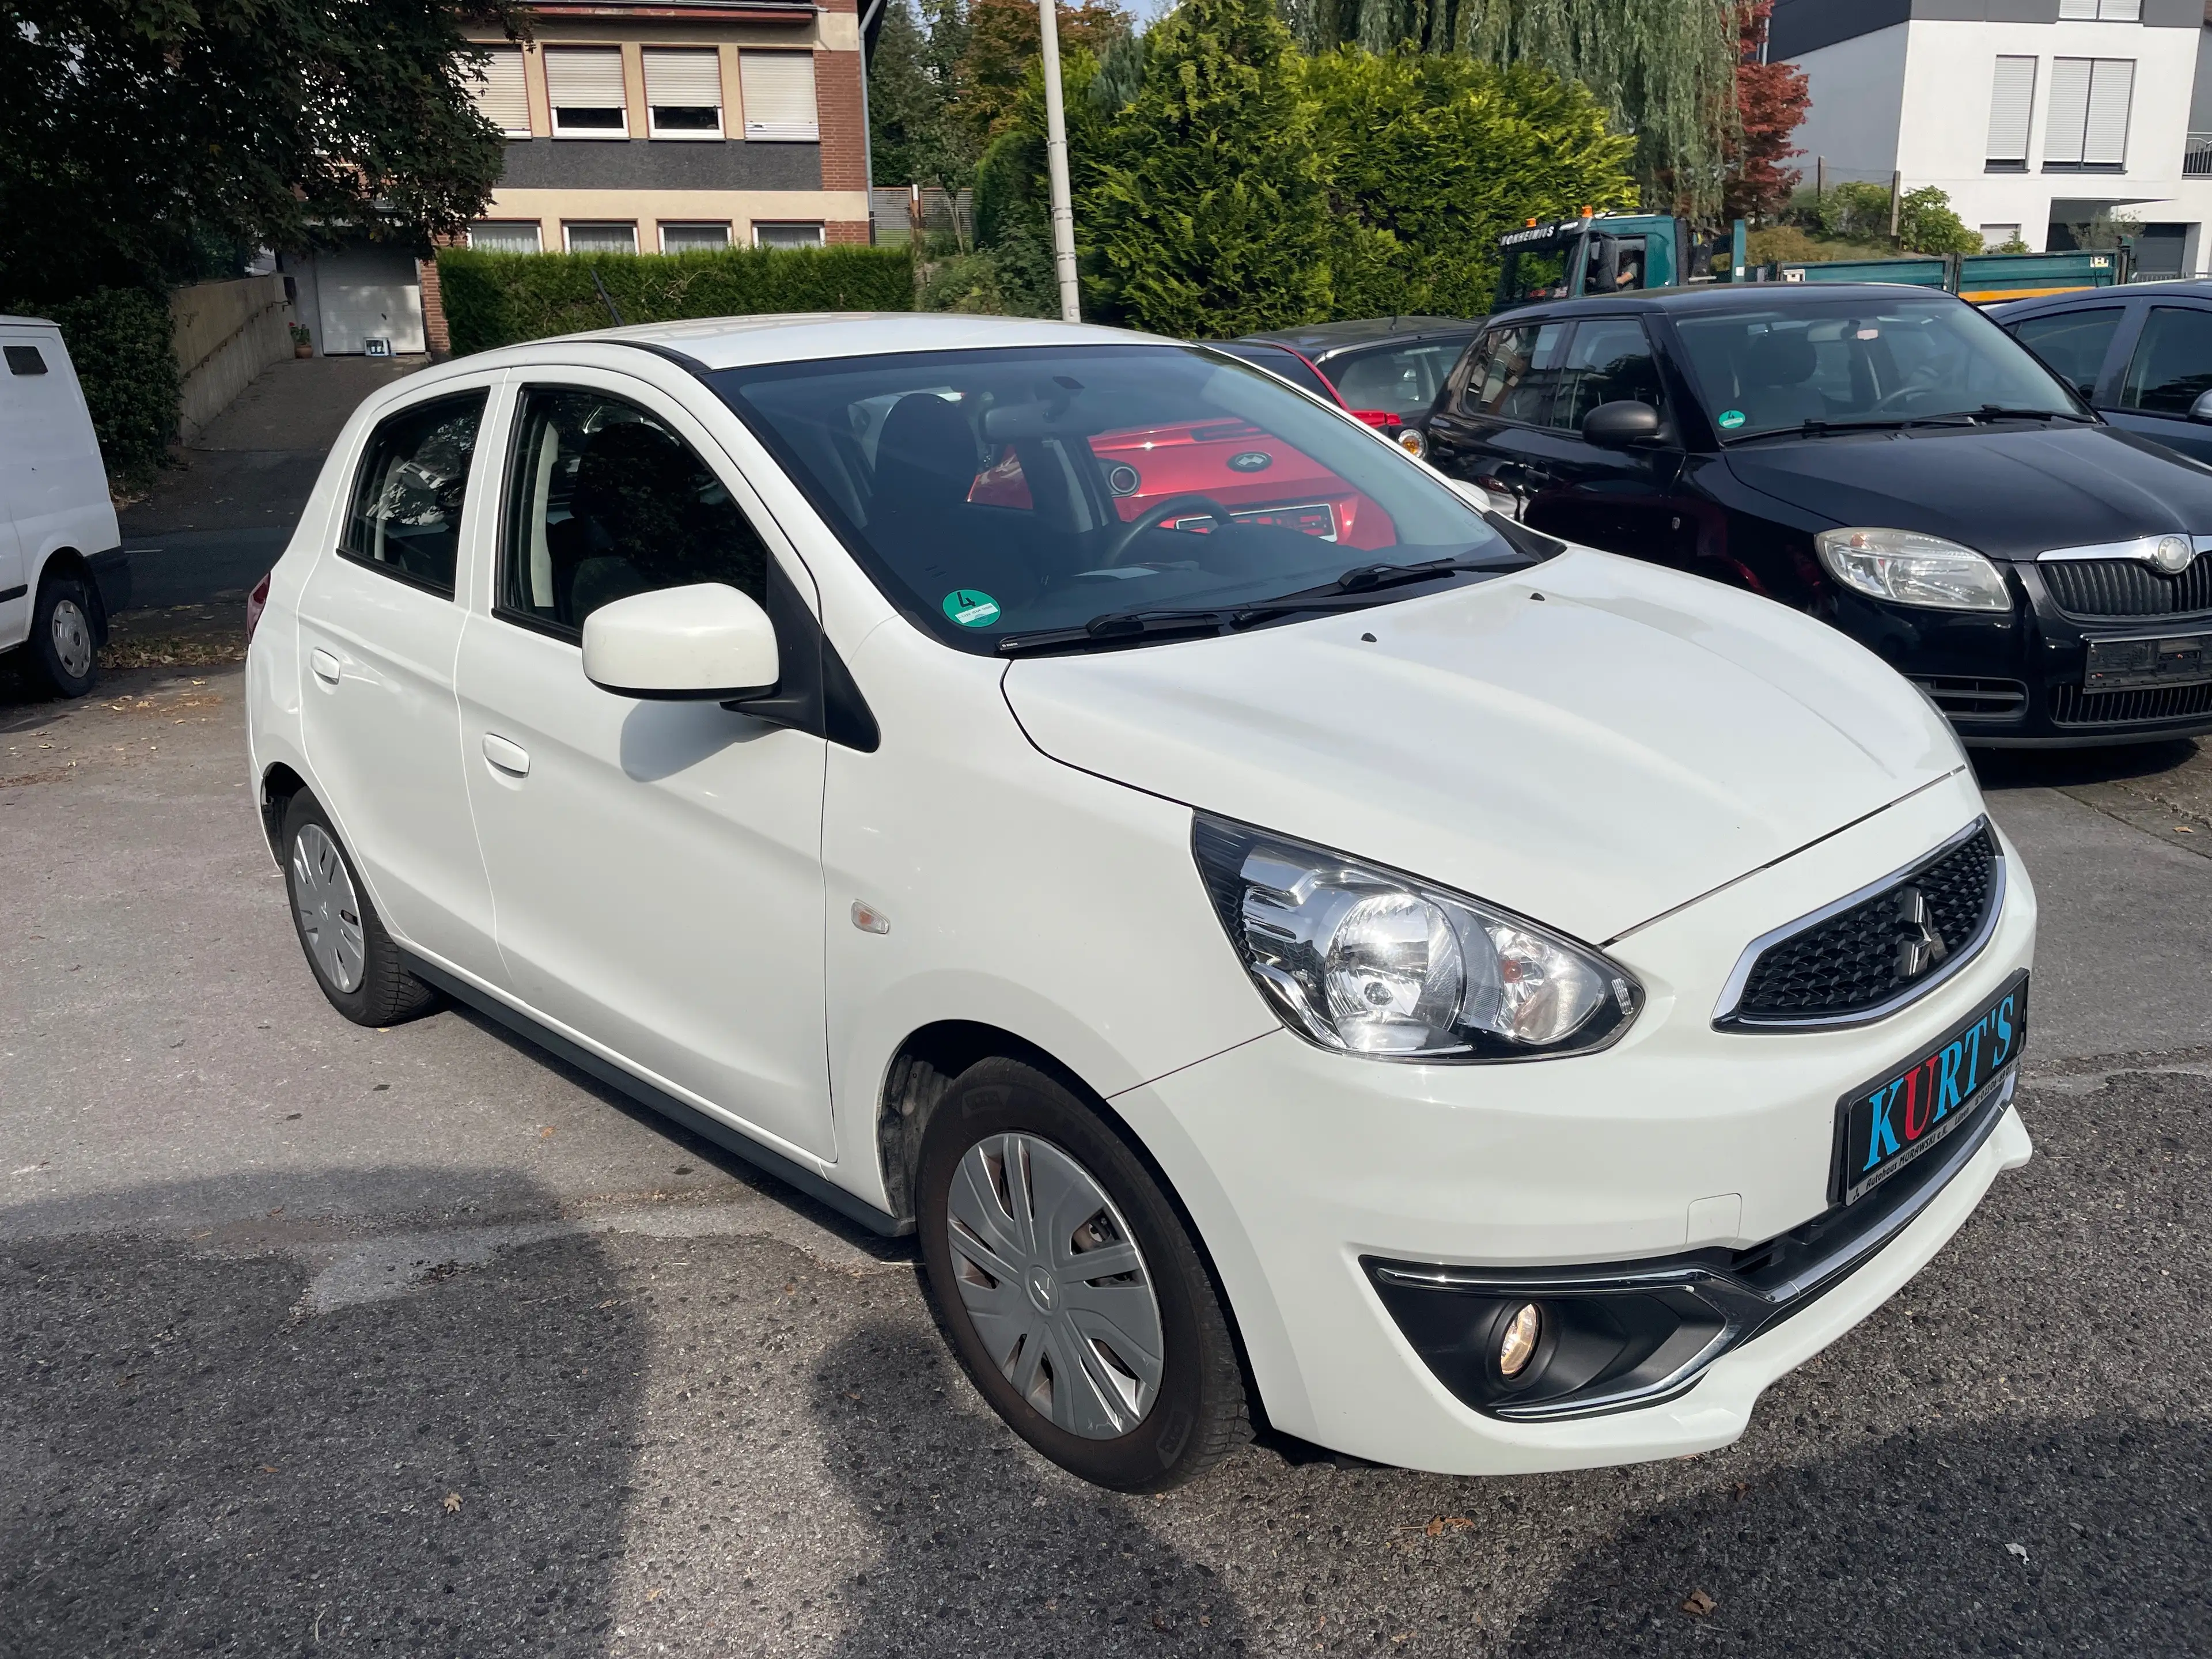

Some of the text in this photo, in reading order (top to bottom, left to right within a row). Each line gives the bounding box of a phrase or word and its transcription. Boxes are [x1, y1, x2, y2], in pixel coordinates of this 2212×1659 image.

[957, 592, 976, 608] 4
[1863, 994, 2014, 1172] KURT'S
[1866, 1162, 1897, 1191] Autohaus
[1899, 1133, 1936, 1166] MURAWSKI
